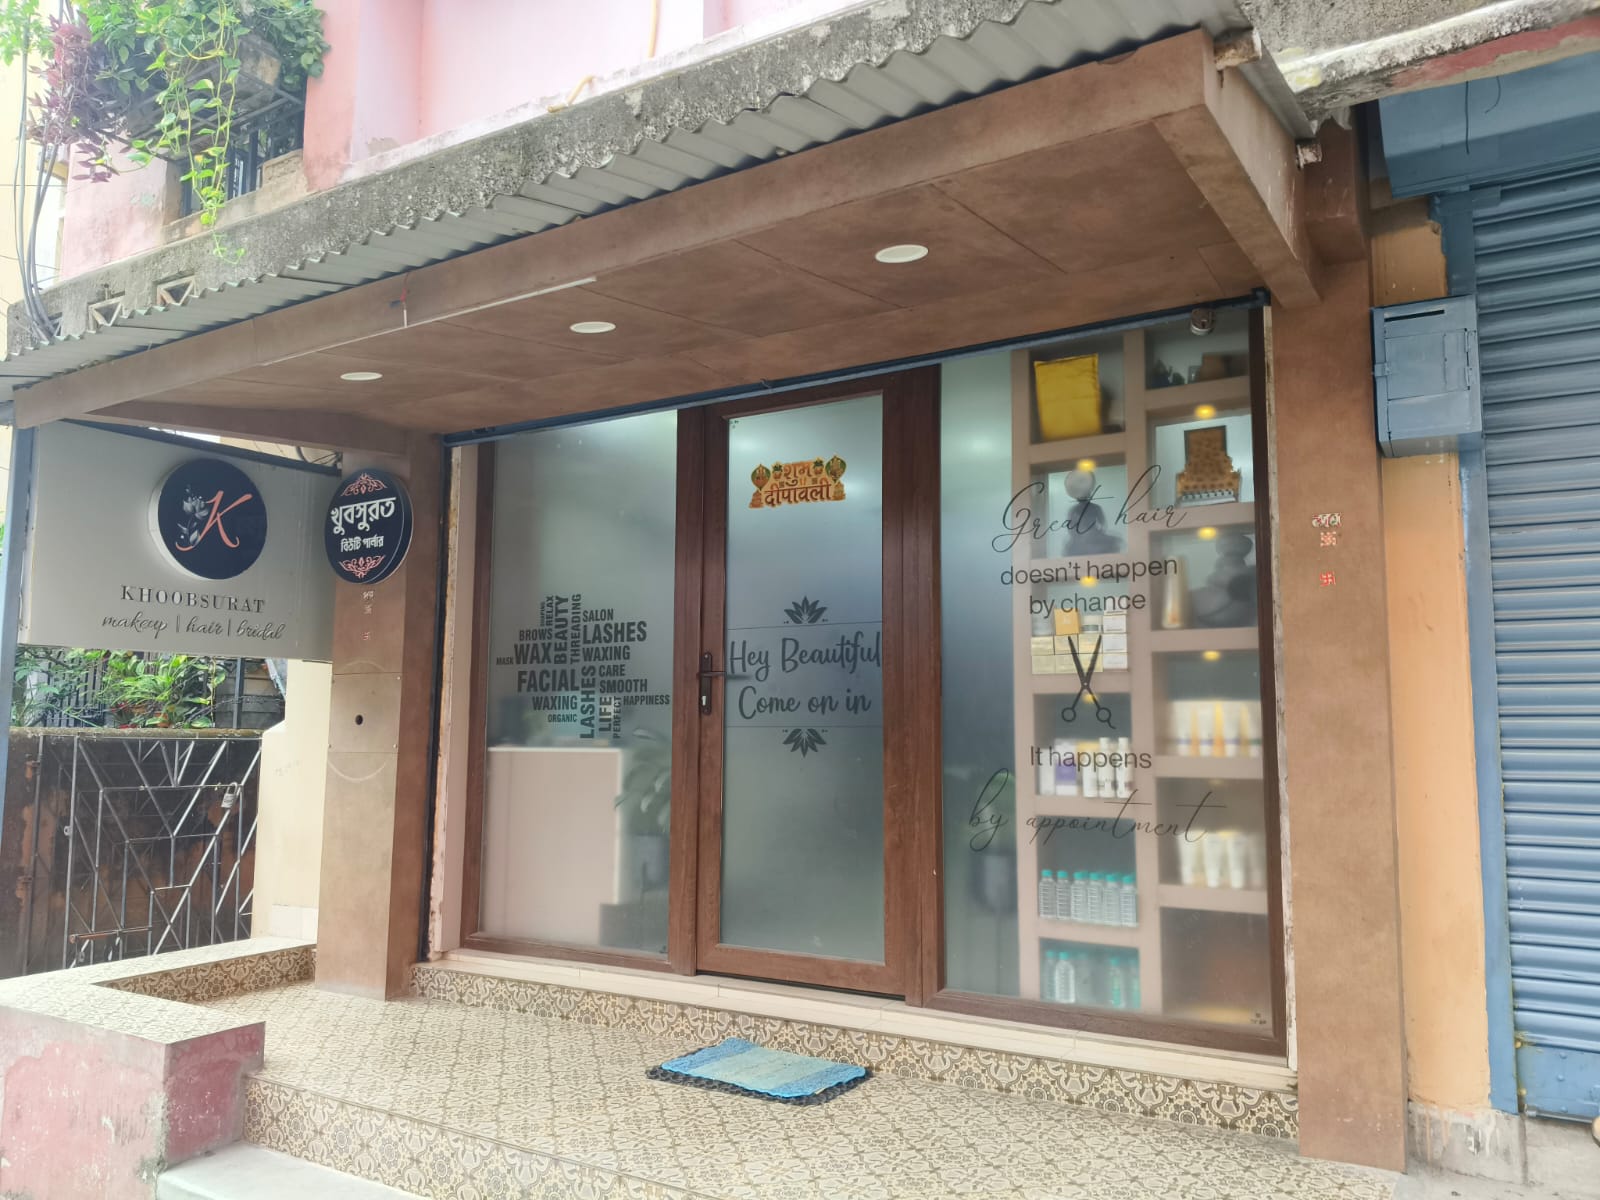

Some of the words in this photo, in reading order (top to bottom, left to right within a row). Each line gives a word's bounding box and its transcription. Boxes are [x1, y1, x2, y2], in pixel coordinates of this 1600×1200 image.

[764, 477, 832, 508] दीपावली
[330, 497, 397, 535] খুবসুরত
[991, 481, 1114, 552] Great
[1114, 464, 1188, 528] hair
[340, 536, 362, 553] বিউটি
[1087, 558, 1178, 584] happen
[120, 584, 266, 614] KHOOBSURAT
[1030, 595, 1056, 619] by
[1061, 593, 1146, 614] chance
[101, 611, 168, 639] makeup
[186, 616, 223, 635] hair
[236, 619, 287, 641] bridal
[582, 608, 614, 622] SALON
[519, 628, 553, 641] BROWS
[554, 595, 569, 665] BEAUTY
[570, 593, 581, 664] THREADING
[582, 621, 647, 644] LASHES
[514, 642, 552, 665] WAX
[582, 645, 631, 662] WAXING
[730, 639, 771, 682] Hey
[781, 631, 881, 674] Beautiful
[517, 669, 580, 692] FACIAL
[599, 664, 626, 677] CARE
[600, 679, 648, 693] SMOOTH
[532, 695, 577, 711] WAXING
[580, 665, 597, 738] LASHES
[623, 694, 671, 706] HAPPINESS
[738, 685, 800, 720] Come
[808, 693, 839, 715] on
[846, 688, 871, 715] in
[548, 714, 577, 723] ORGANIC
[599, 696, 612, 732] LIFE
[612, 695, 622, 739] PERFECT
[1030, 746, 1042, 766] It
[1049, 746, 1152, 772] happens
[968, 768, 1009, 852] by
[1026, 789, 1227, 845] appointment
